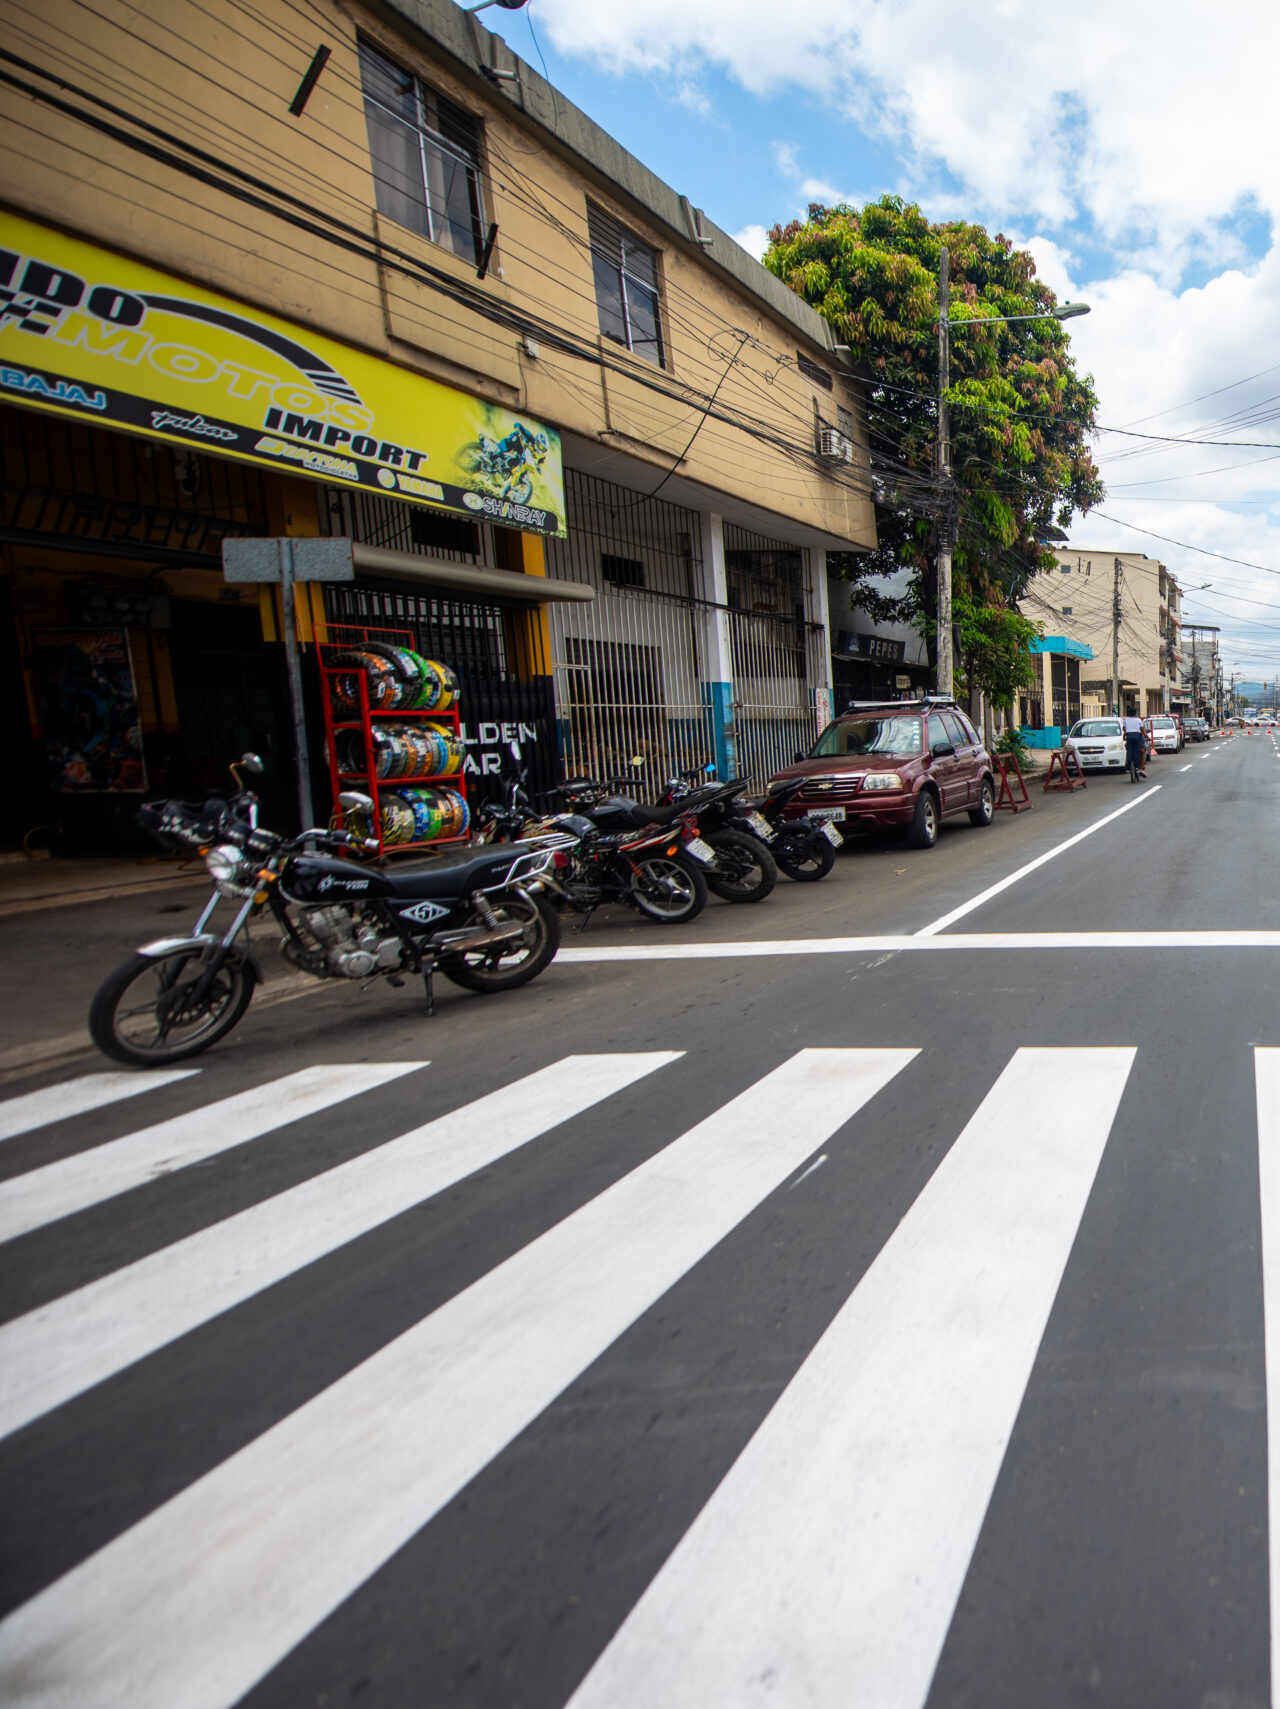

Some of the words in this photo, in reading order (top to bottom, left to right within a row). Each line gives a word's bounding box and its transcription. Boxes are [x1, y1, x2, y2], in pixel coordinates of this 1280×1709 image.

[50, 309, 375, 433] MOTOS
[0, 366, 107, 410] BAJAJ
[262, 404, 429, 474] IMPORT
[397, 473, 445, 501] YAMAHA
[482, 497, 547, 527] SHINERAY
[869, 639, 899, 659] PEPES
[459, 722, 537, 744] LDEN
[463, 752, 501, 775] AR
